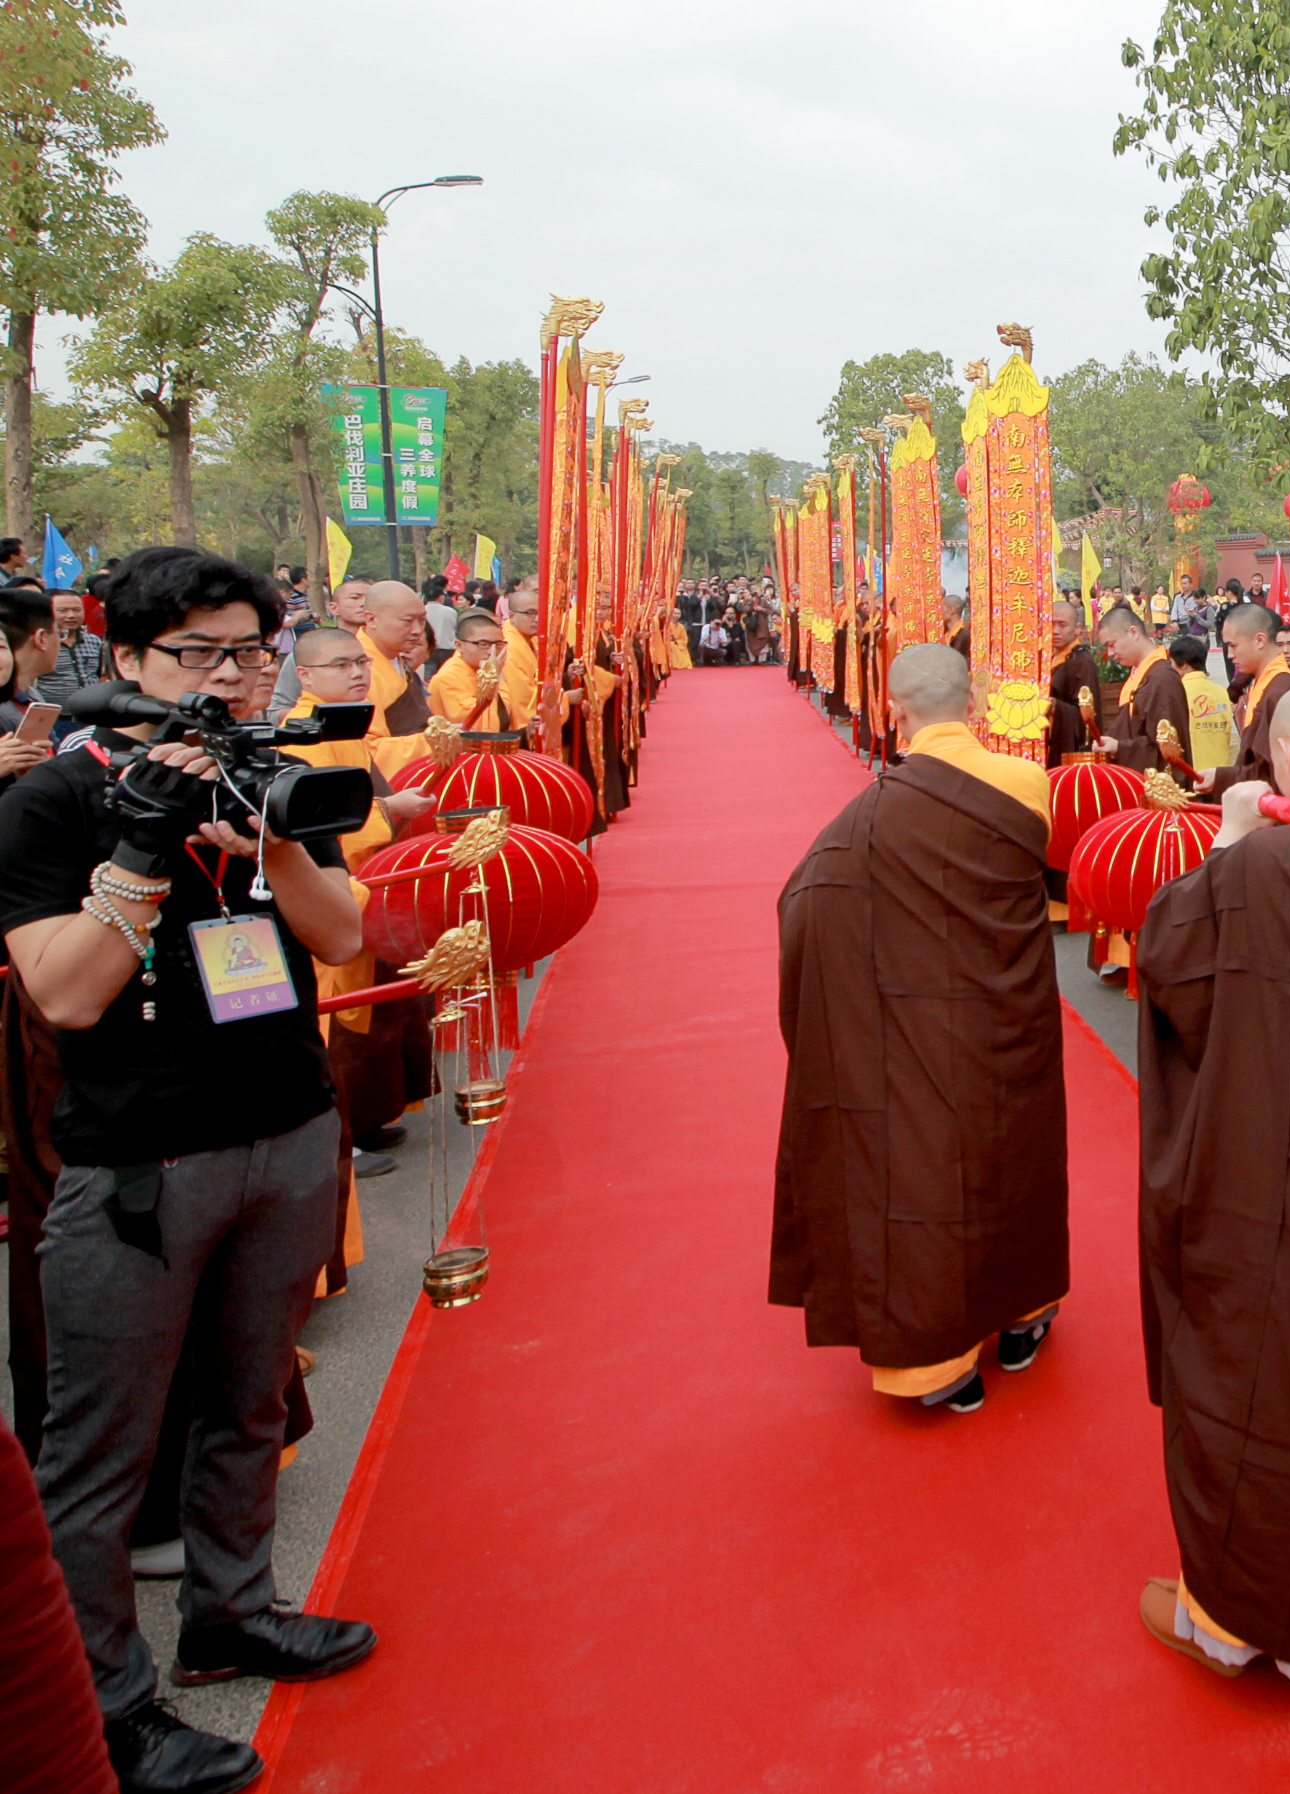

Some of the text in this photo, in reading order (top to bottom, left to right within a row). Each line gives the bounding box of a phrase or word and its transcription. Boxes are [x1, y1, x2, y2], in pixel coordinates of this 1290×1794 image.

[343, 414, 368, 510] 巴伐利亚庄园
[399, 447, 419, 510] 三养度假
[417, 416, 436, 478] 启幕全球
[1005, 423, 1032, 671] 南無本師釋迦牟尼佛
[229, 990, 281, 1010] 记者证
